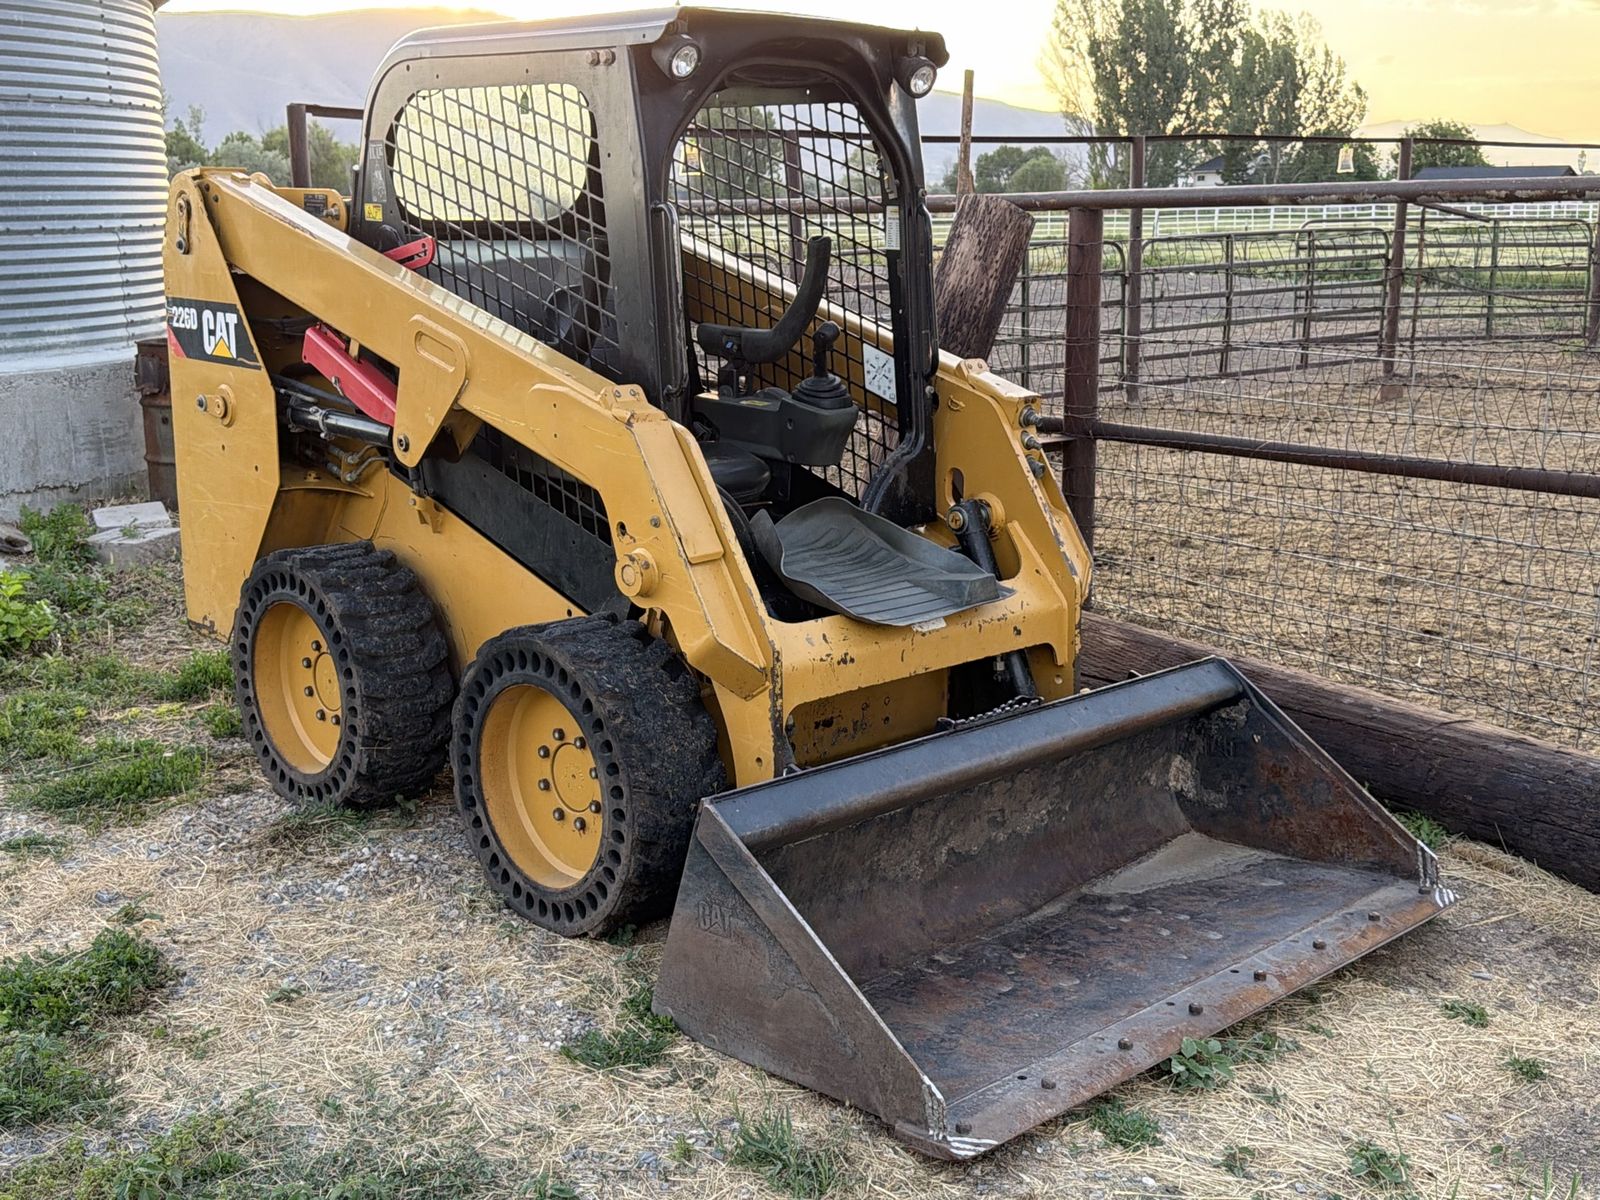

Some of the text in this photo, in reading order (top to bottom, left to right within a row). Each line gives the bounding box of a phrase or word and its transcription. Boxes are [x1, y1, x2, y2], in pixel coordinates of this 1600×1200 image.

[171, 306, 238, 359] 226D CAT
[696, 900, 732, 935] CAT
